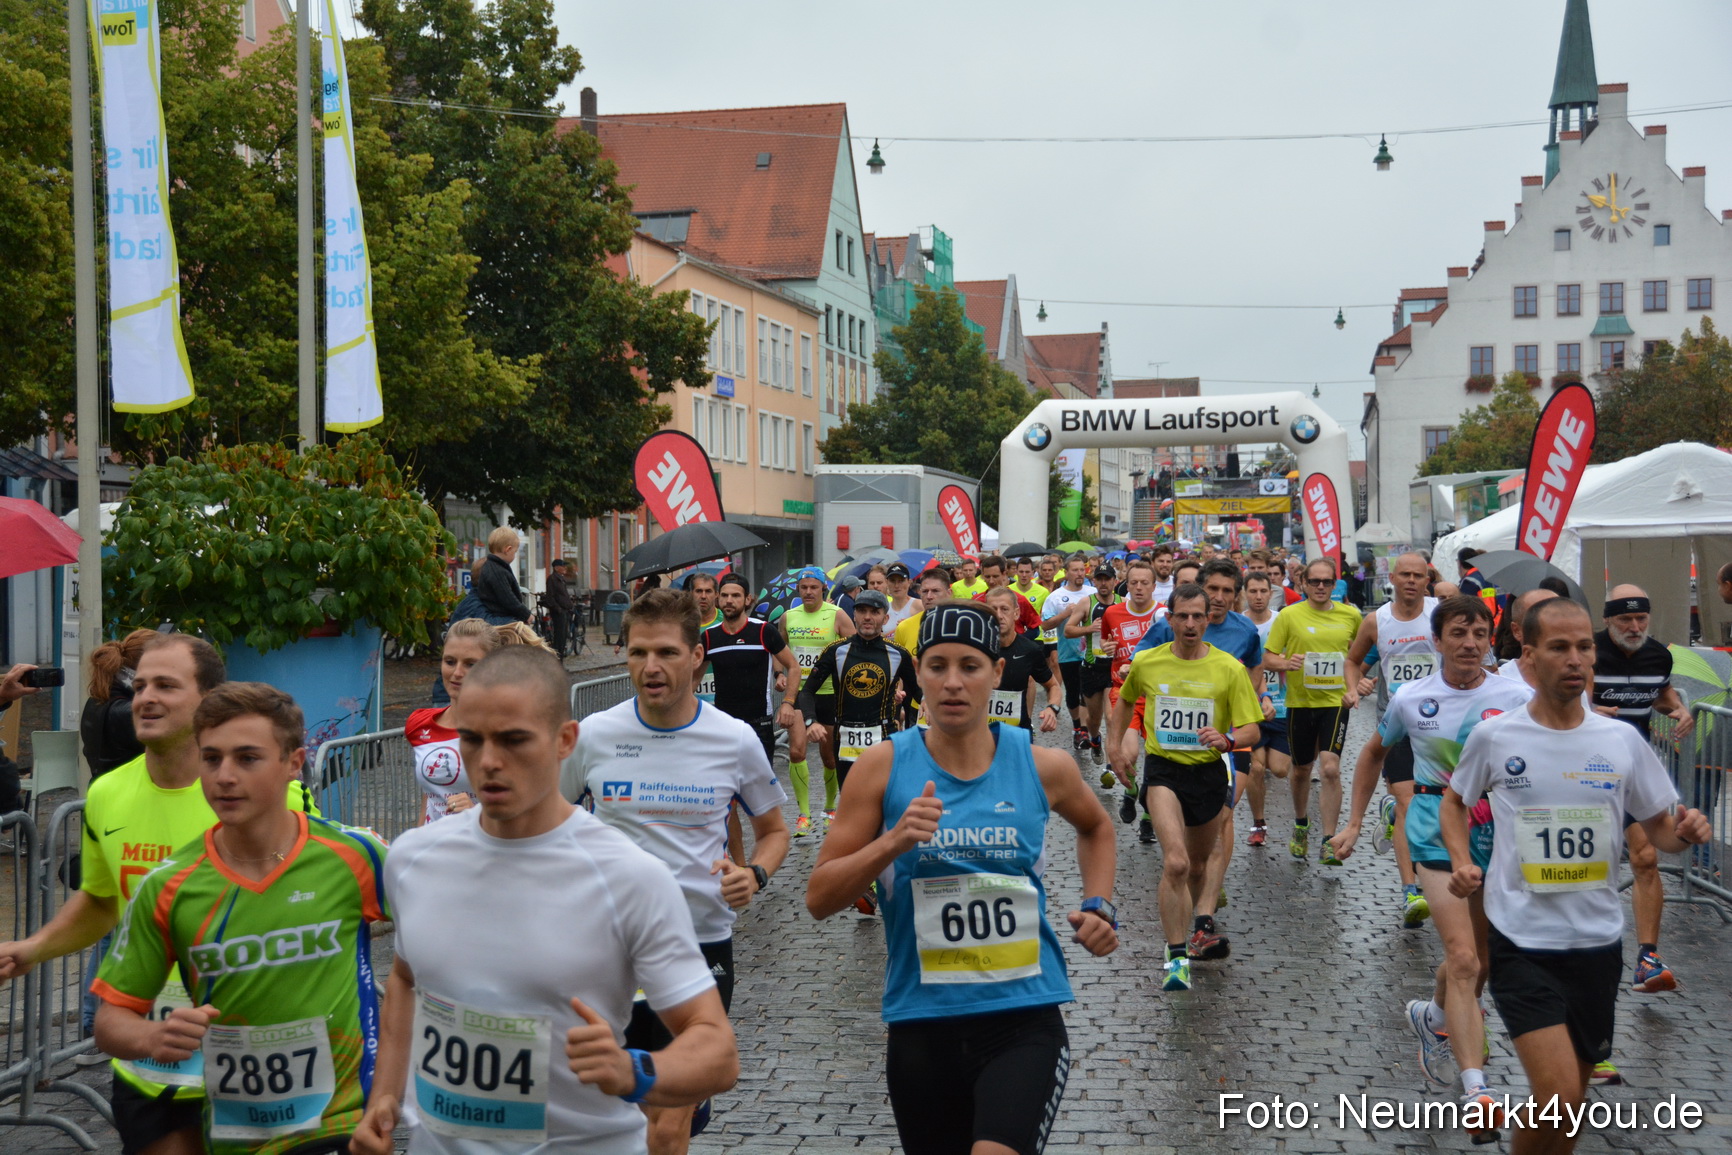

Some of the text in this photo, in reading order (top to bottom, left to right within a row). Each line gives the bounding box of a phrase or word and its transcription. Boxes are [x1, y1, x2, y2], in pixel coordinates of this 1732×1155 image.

[1061, 405, 1279, 433] BMW Laufsport
[1524, 408, 1586, 560] REWE
[1220, 501, 1246, 511] ZIEL
[1313, 662, 1336, 675] 171
[1393, 664, 1433, 680] 2627
[1160, 709, 1208, 730] 2010
[848, 731, 873, 746] 618
[1167, 734, 1197, 743] Damian
[639, 782, 715, 795] Raiffeisenbank
[639, 794, 715, 806] am Rothsee eG
[1557, 808, 1603, 819] BOCK
[1535, 827, 1595, 859] 168
[1541, 867, 1588, 880] Michael
[923, 887, 961, 895] NeuerMarkt
[941, 896, 1017, 942] 606
[188, 919, 343, 978] BOCK
[250, 1022, 315, 1043] BOCK
[463, 1010, 537, 1035] BOCK
[421, 1025, 535, 1095] 2904
[216, 1046, 318, 1096] 2887
[433, 1093, 506, 1124] Richard
[1035, 1046, 1070, 1155] skinfit
[248, 1104, 296, 1123] David
